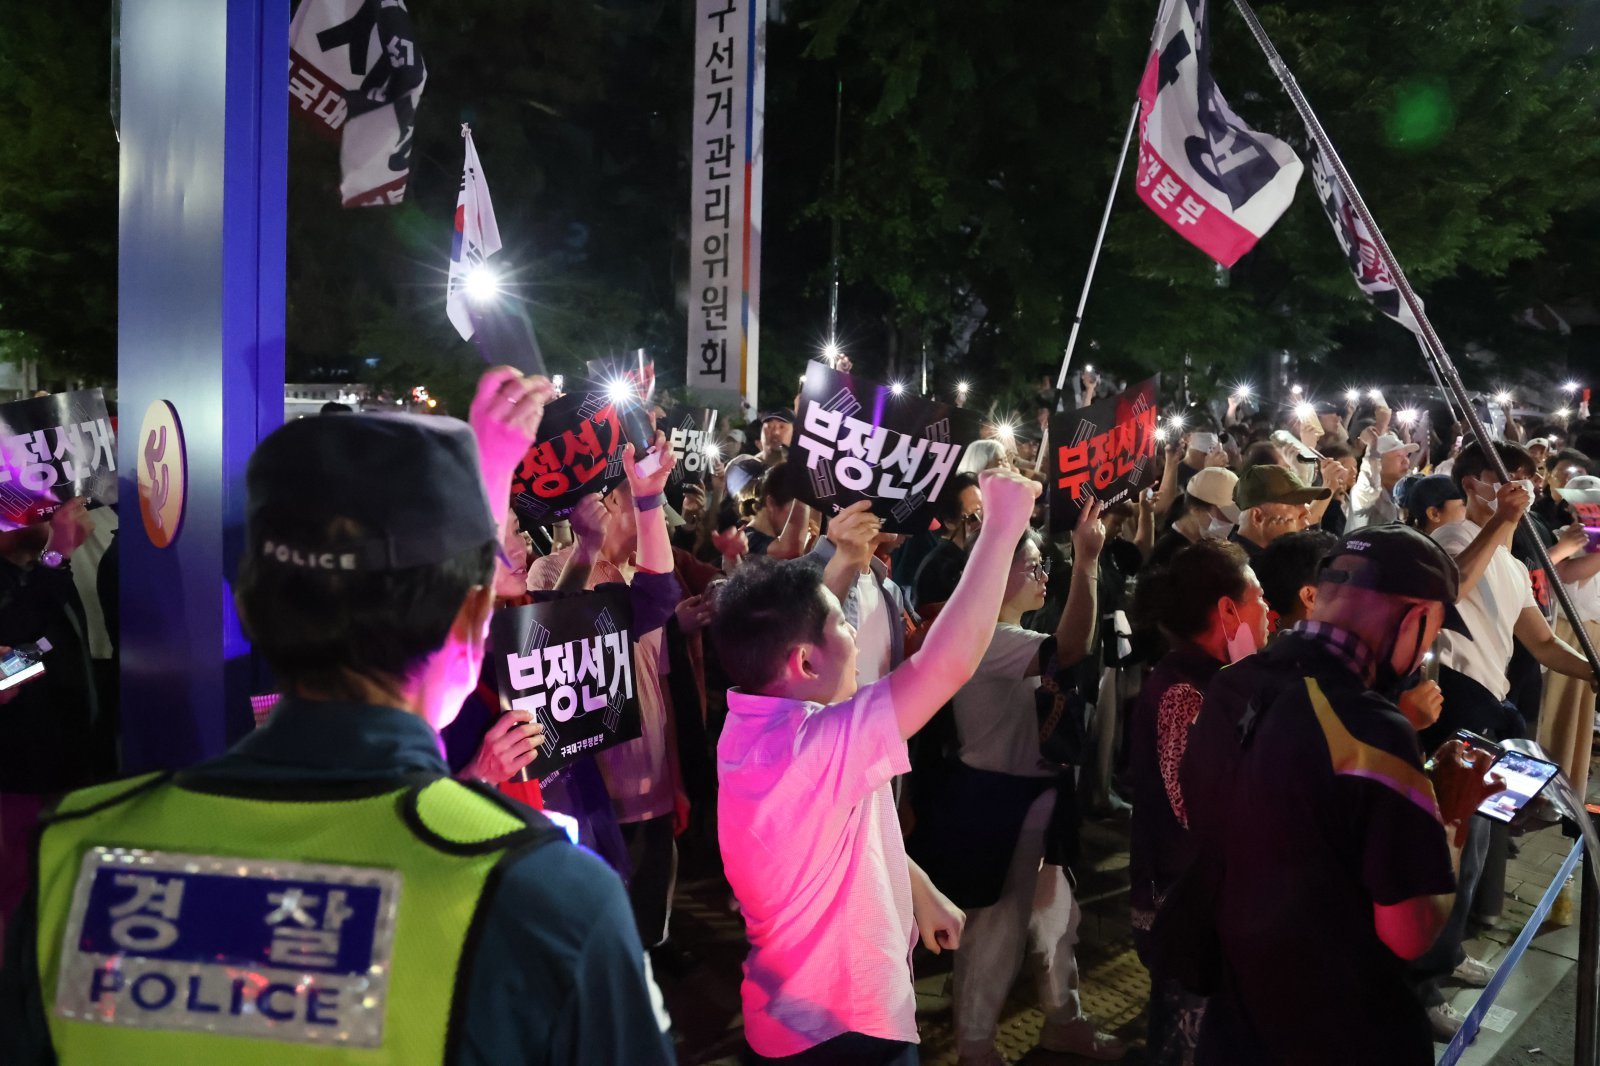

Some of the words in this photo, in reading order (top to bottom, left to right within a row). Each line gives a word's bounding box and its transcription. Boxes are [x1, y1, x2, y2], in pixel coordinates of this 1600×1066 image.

[797, 400, 962, 503] 부정선거
[1058, 404, 1157, 500] 부정선거
[263, 540, 356, 570] POLICE
[506, 629, 633, 724] 부정선거
[560, 733, 604, 758] 구국대구투쟁본부
[109, 873, 354, 967] 경찰
[89, 967, 340, 1026] POLICE
